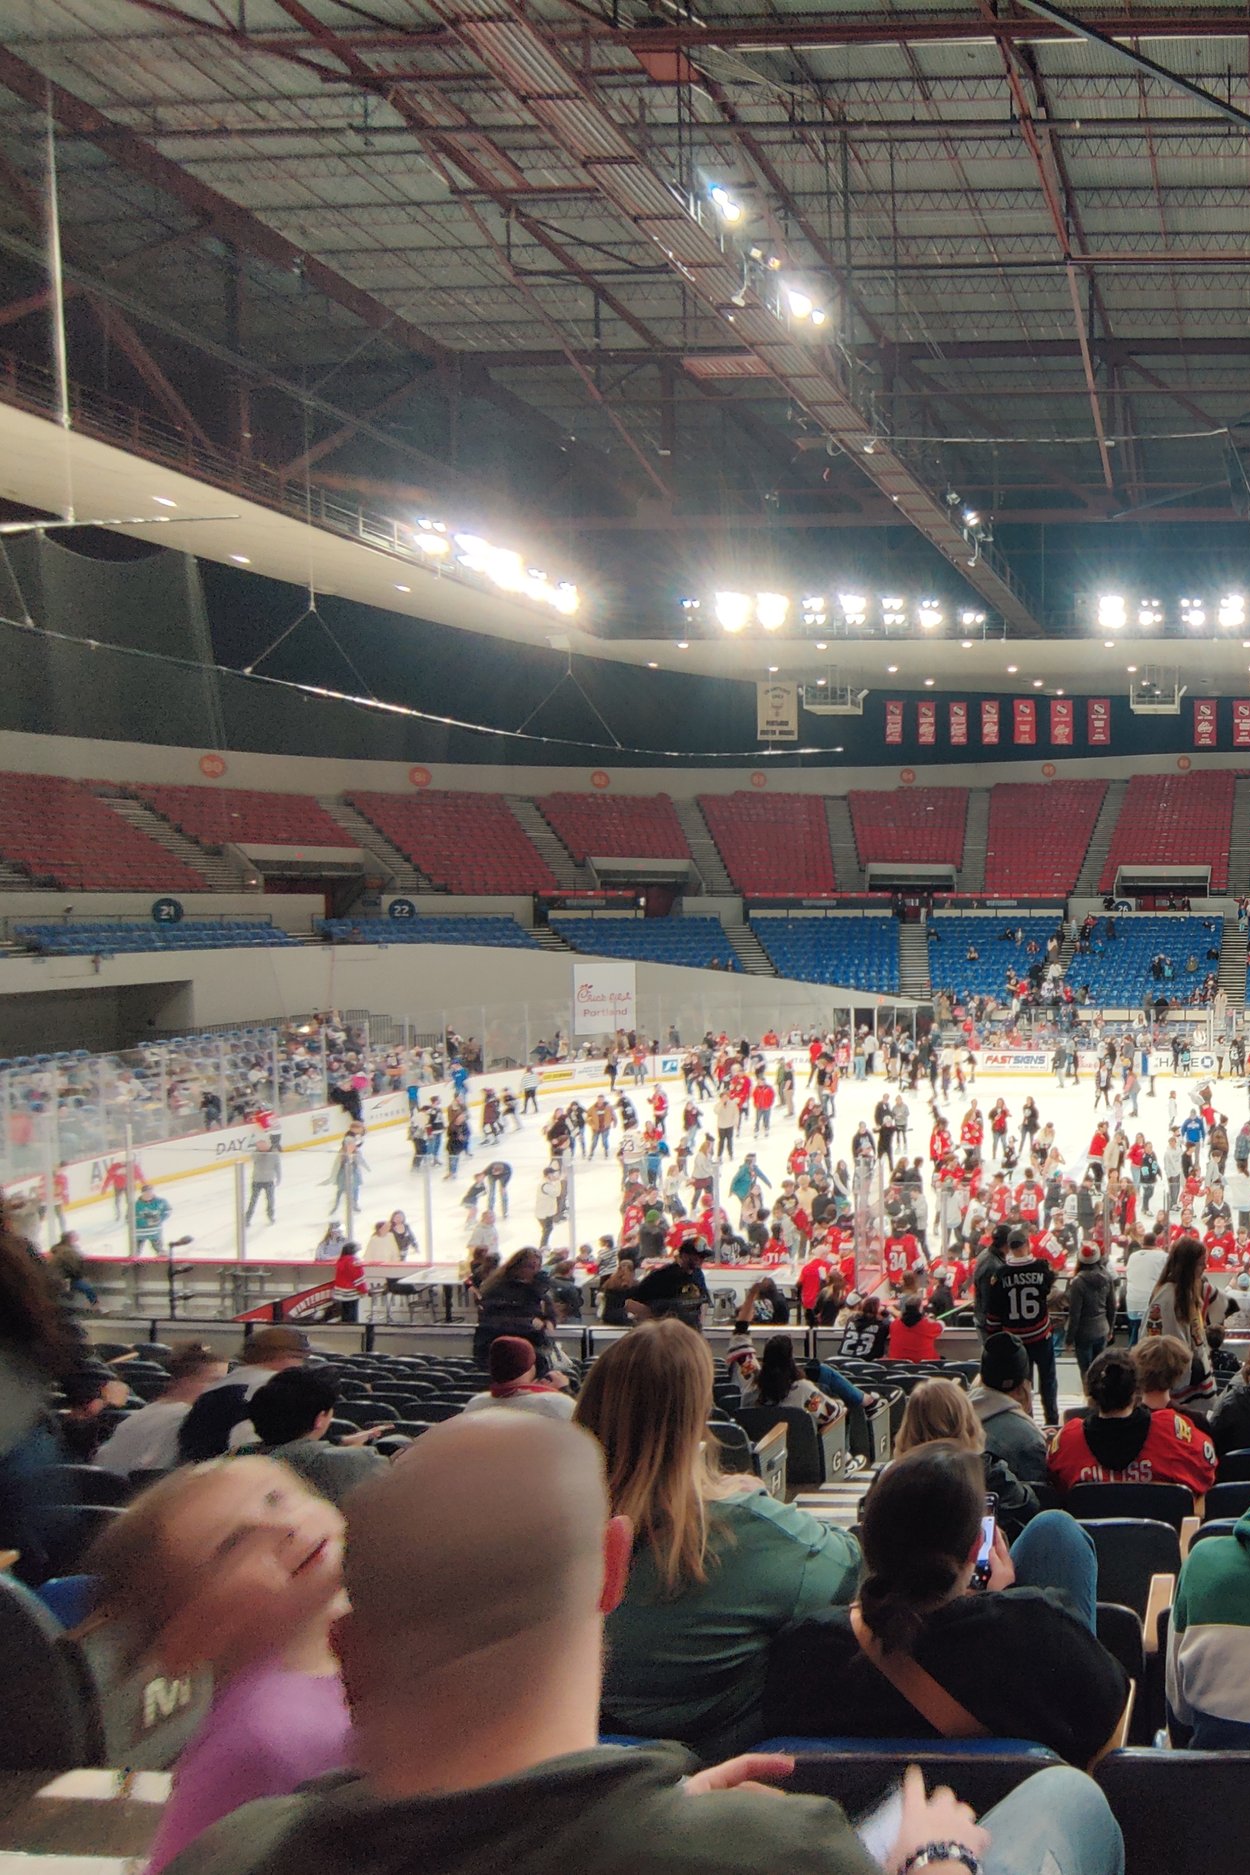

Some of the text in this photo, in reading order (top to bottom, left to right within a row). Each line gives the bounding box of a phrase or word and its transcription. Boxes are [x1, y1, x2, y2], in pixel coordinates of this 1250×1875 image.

[160, 905, 175, 919] 21
[394, 905, 409, 917] 22
[583, 1008, 628, 1017] Portland
[985, 1055, 1046, 1065] FASTSIGNS
[1001, 1272, 1044, 1289] KLASSEN
[1008, 1286, 1040, 1320] 16
[841, 1331, 876, 1356] 23
[880, 1435, 887, 1453] F
[832, 1451, 842, 1471] G
[772, 1470, 782, 1493] H
